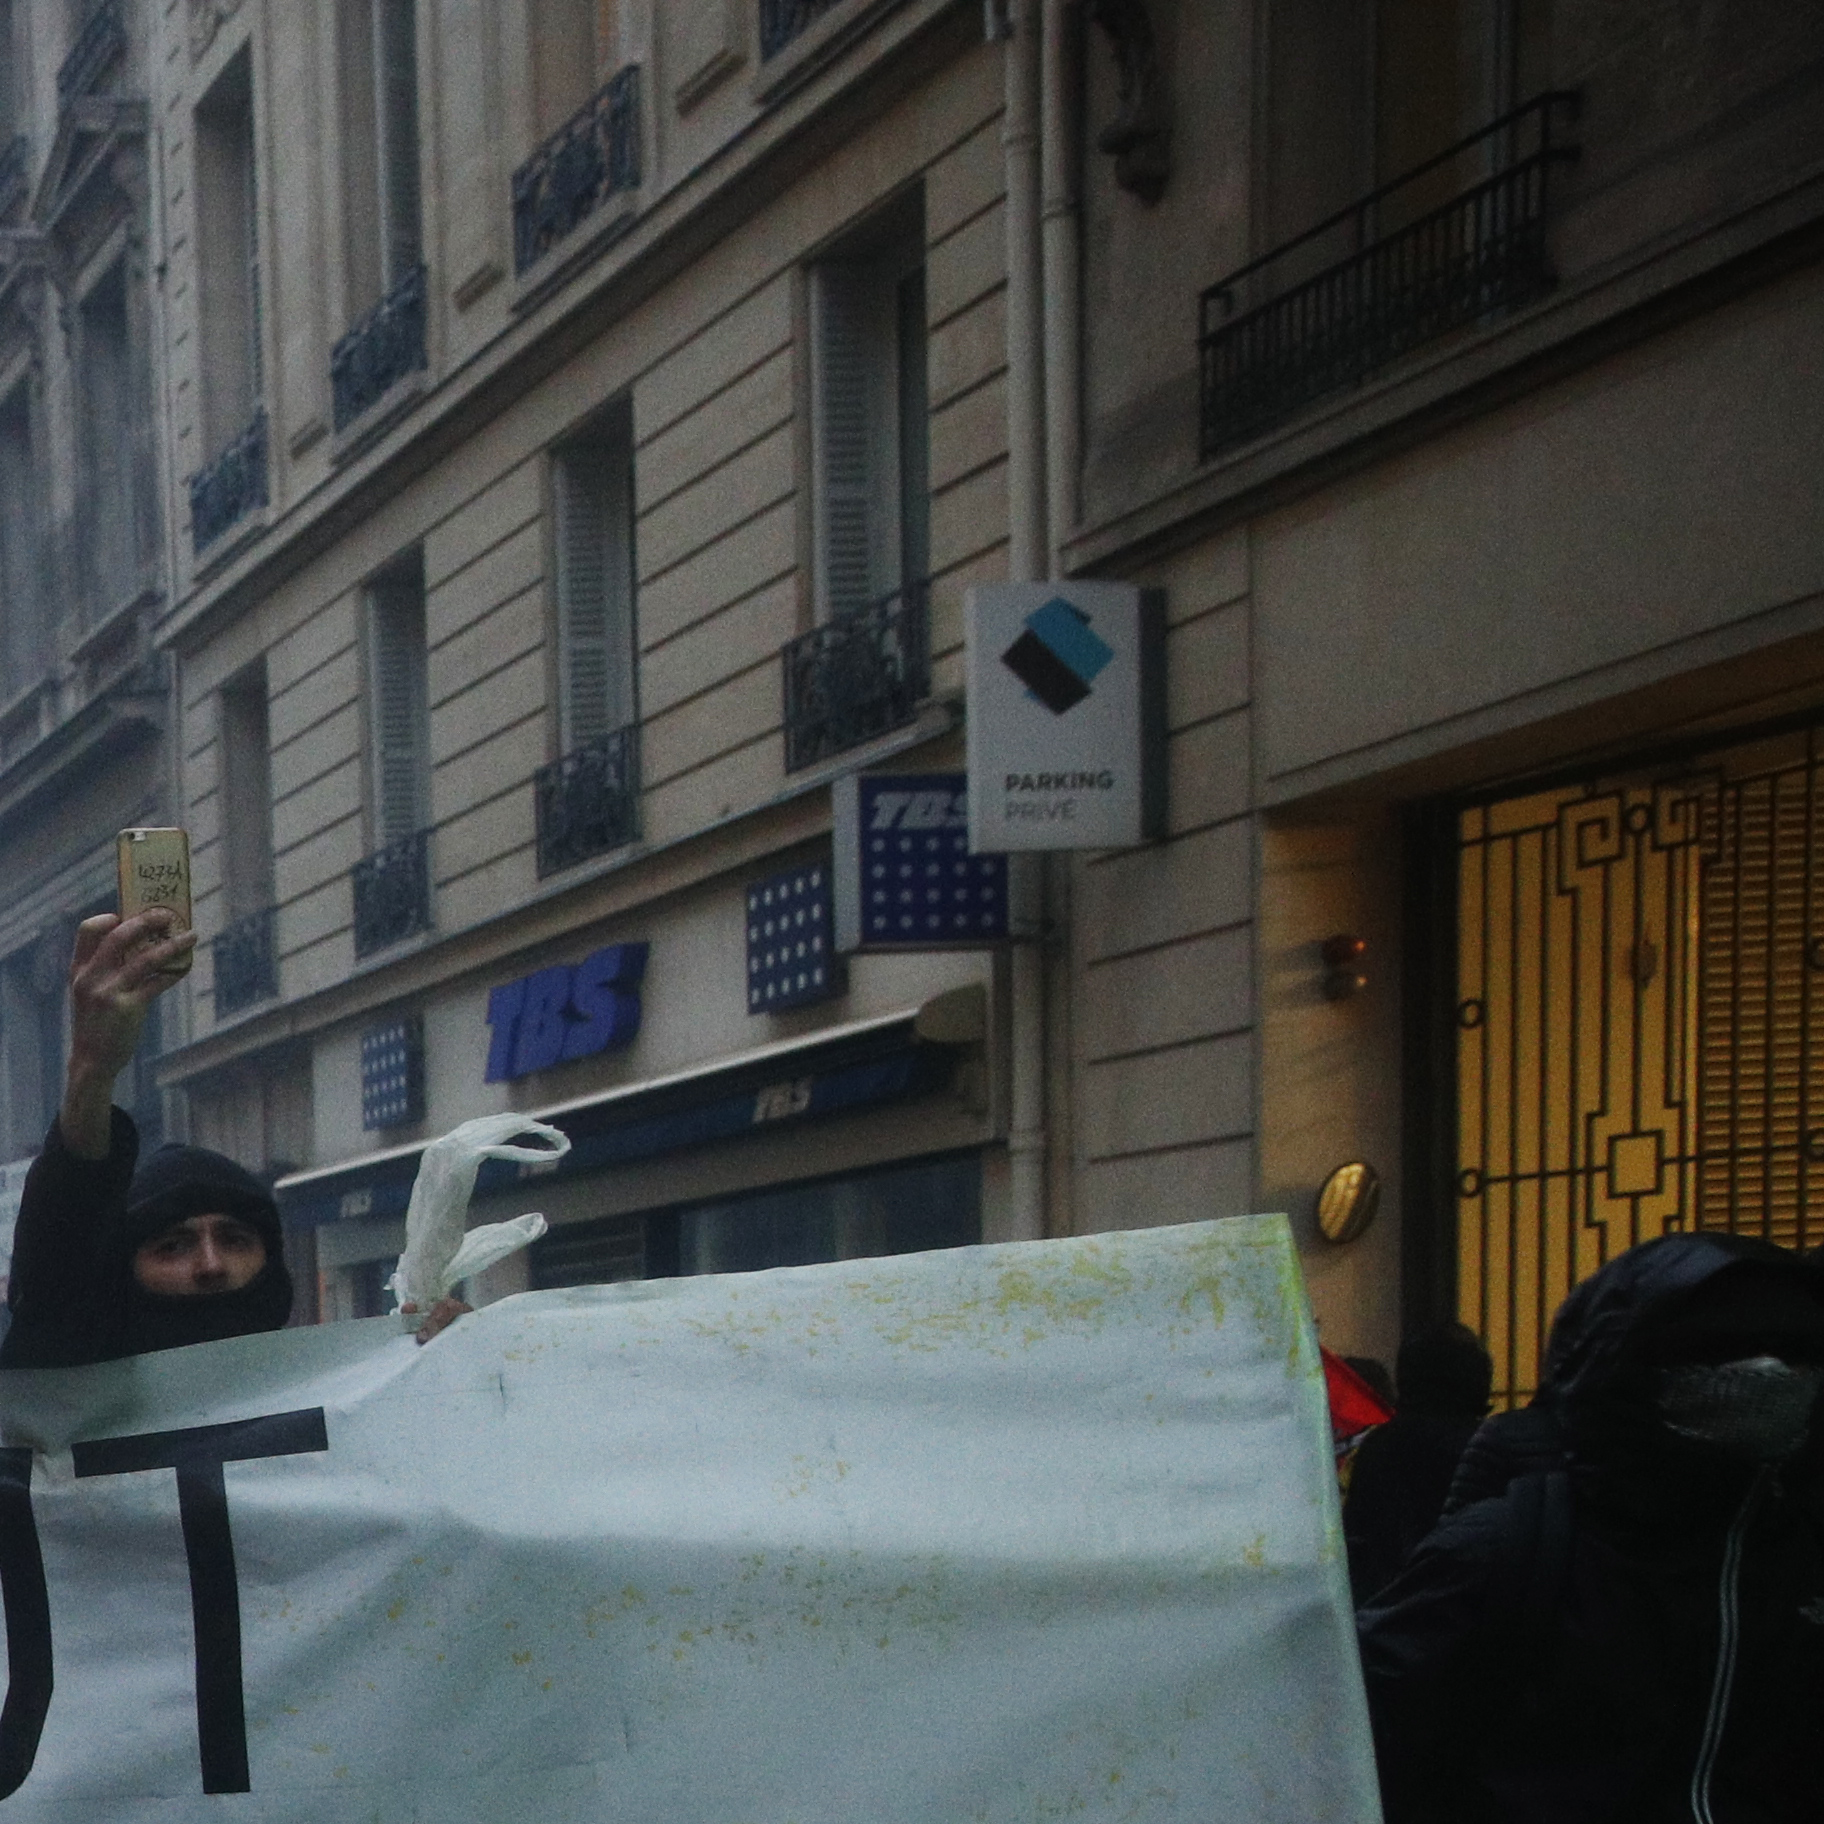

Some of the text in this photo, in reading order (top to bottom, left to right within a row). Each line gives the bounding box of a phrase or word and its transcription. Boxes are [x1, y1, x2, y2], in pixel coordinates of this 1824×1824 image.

[1005, 770, 1115, 792] PARKING
[484, 941, 650, 1084] TBS
[754, 1076, 813, 1122] TBS
